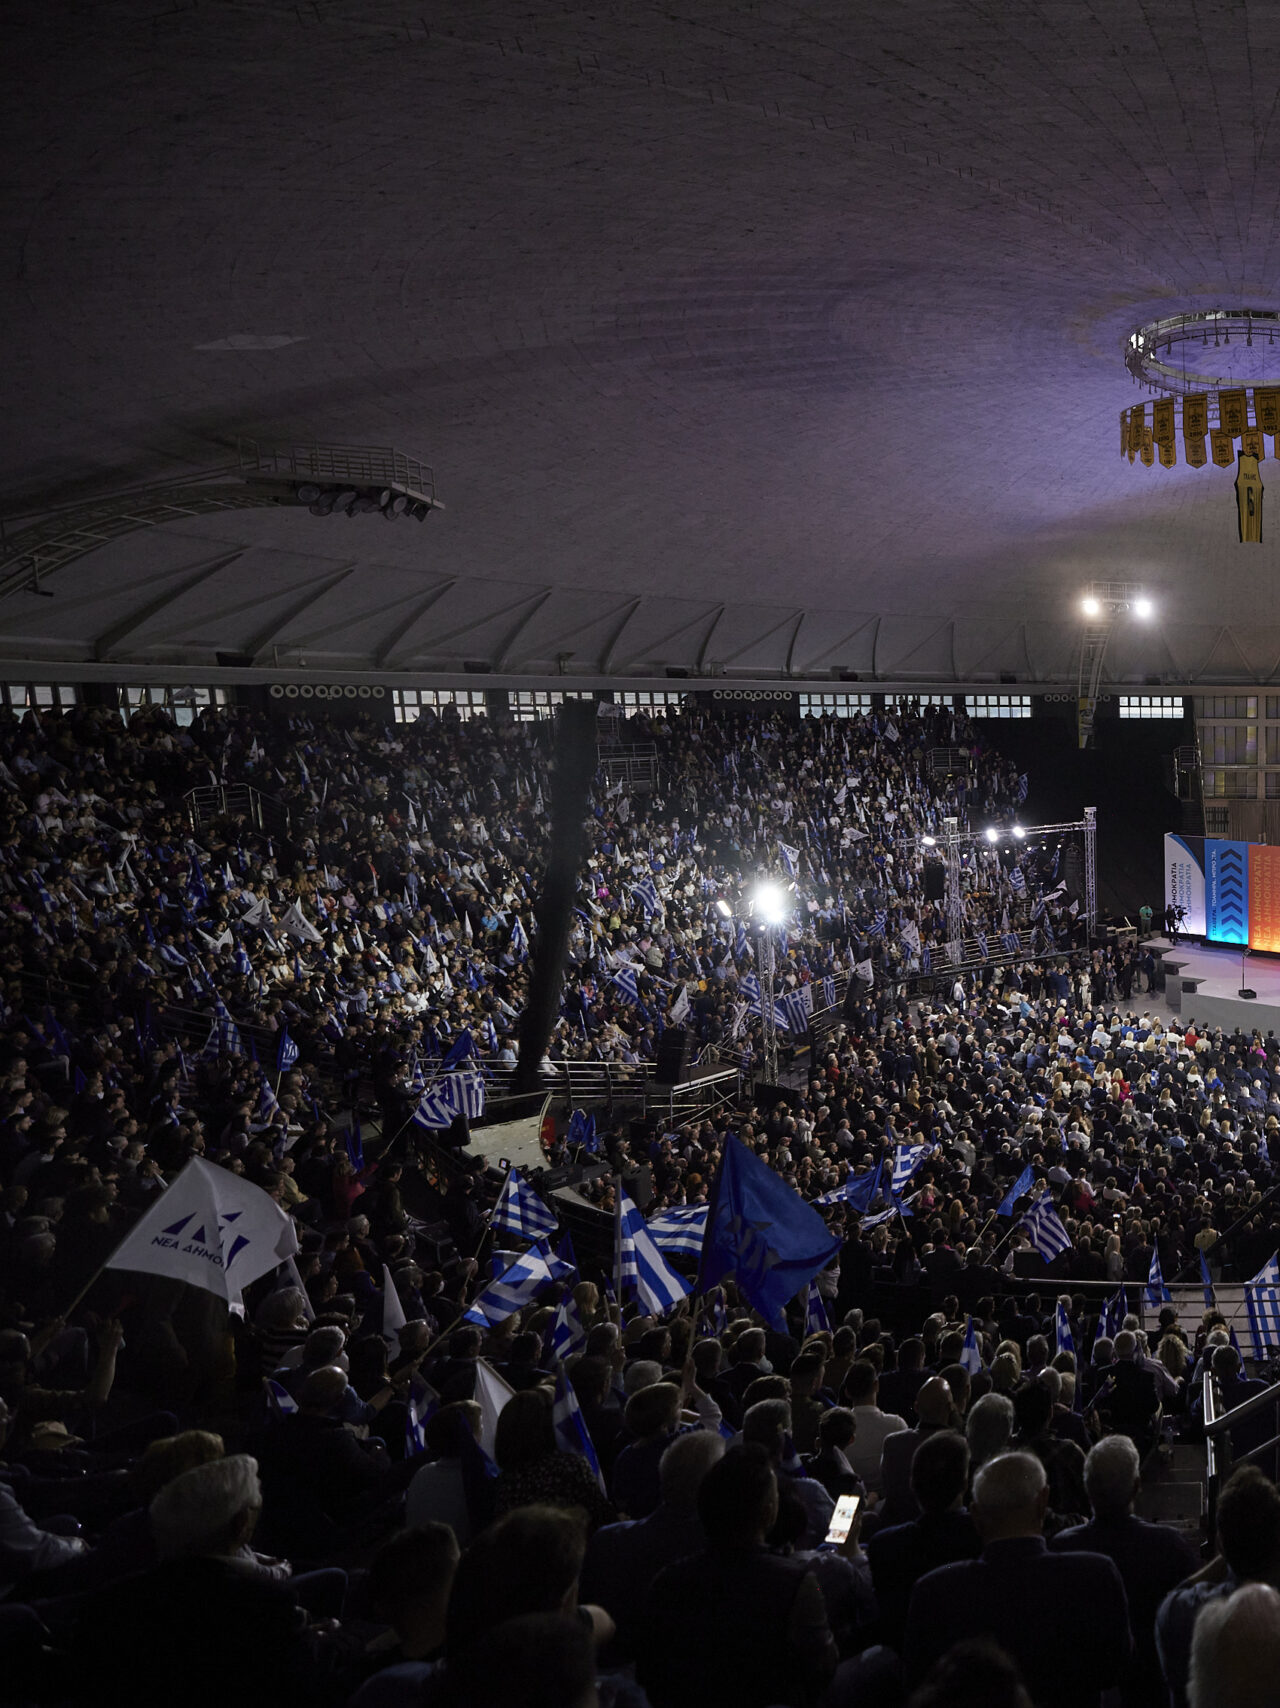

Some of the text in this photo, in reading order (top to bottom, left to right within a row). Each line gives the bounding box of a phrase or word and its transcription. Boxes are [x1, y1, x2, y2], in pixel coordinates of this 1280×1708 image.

[1253, 854, 1262, 922] ΔΗΜΟΚΡΑΤΙΑ
[1263, 855, 1271, 947] ΝΕΑ ΔΗΜΟΚΡΑΤΙΑ
[151, 1236, 180, 1250] ΝΕΑ
